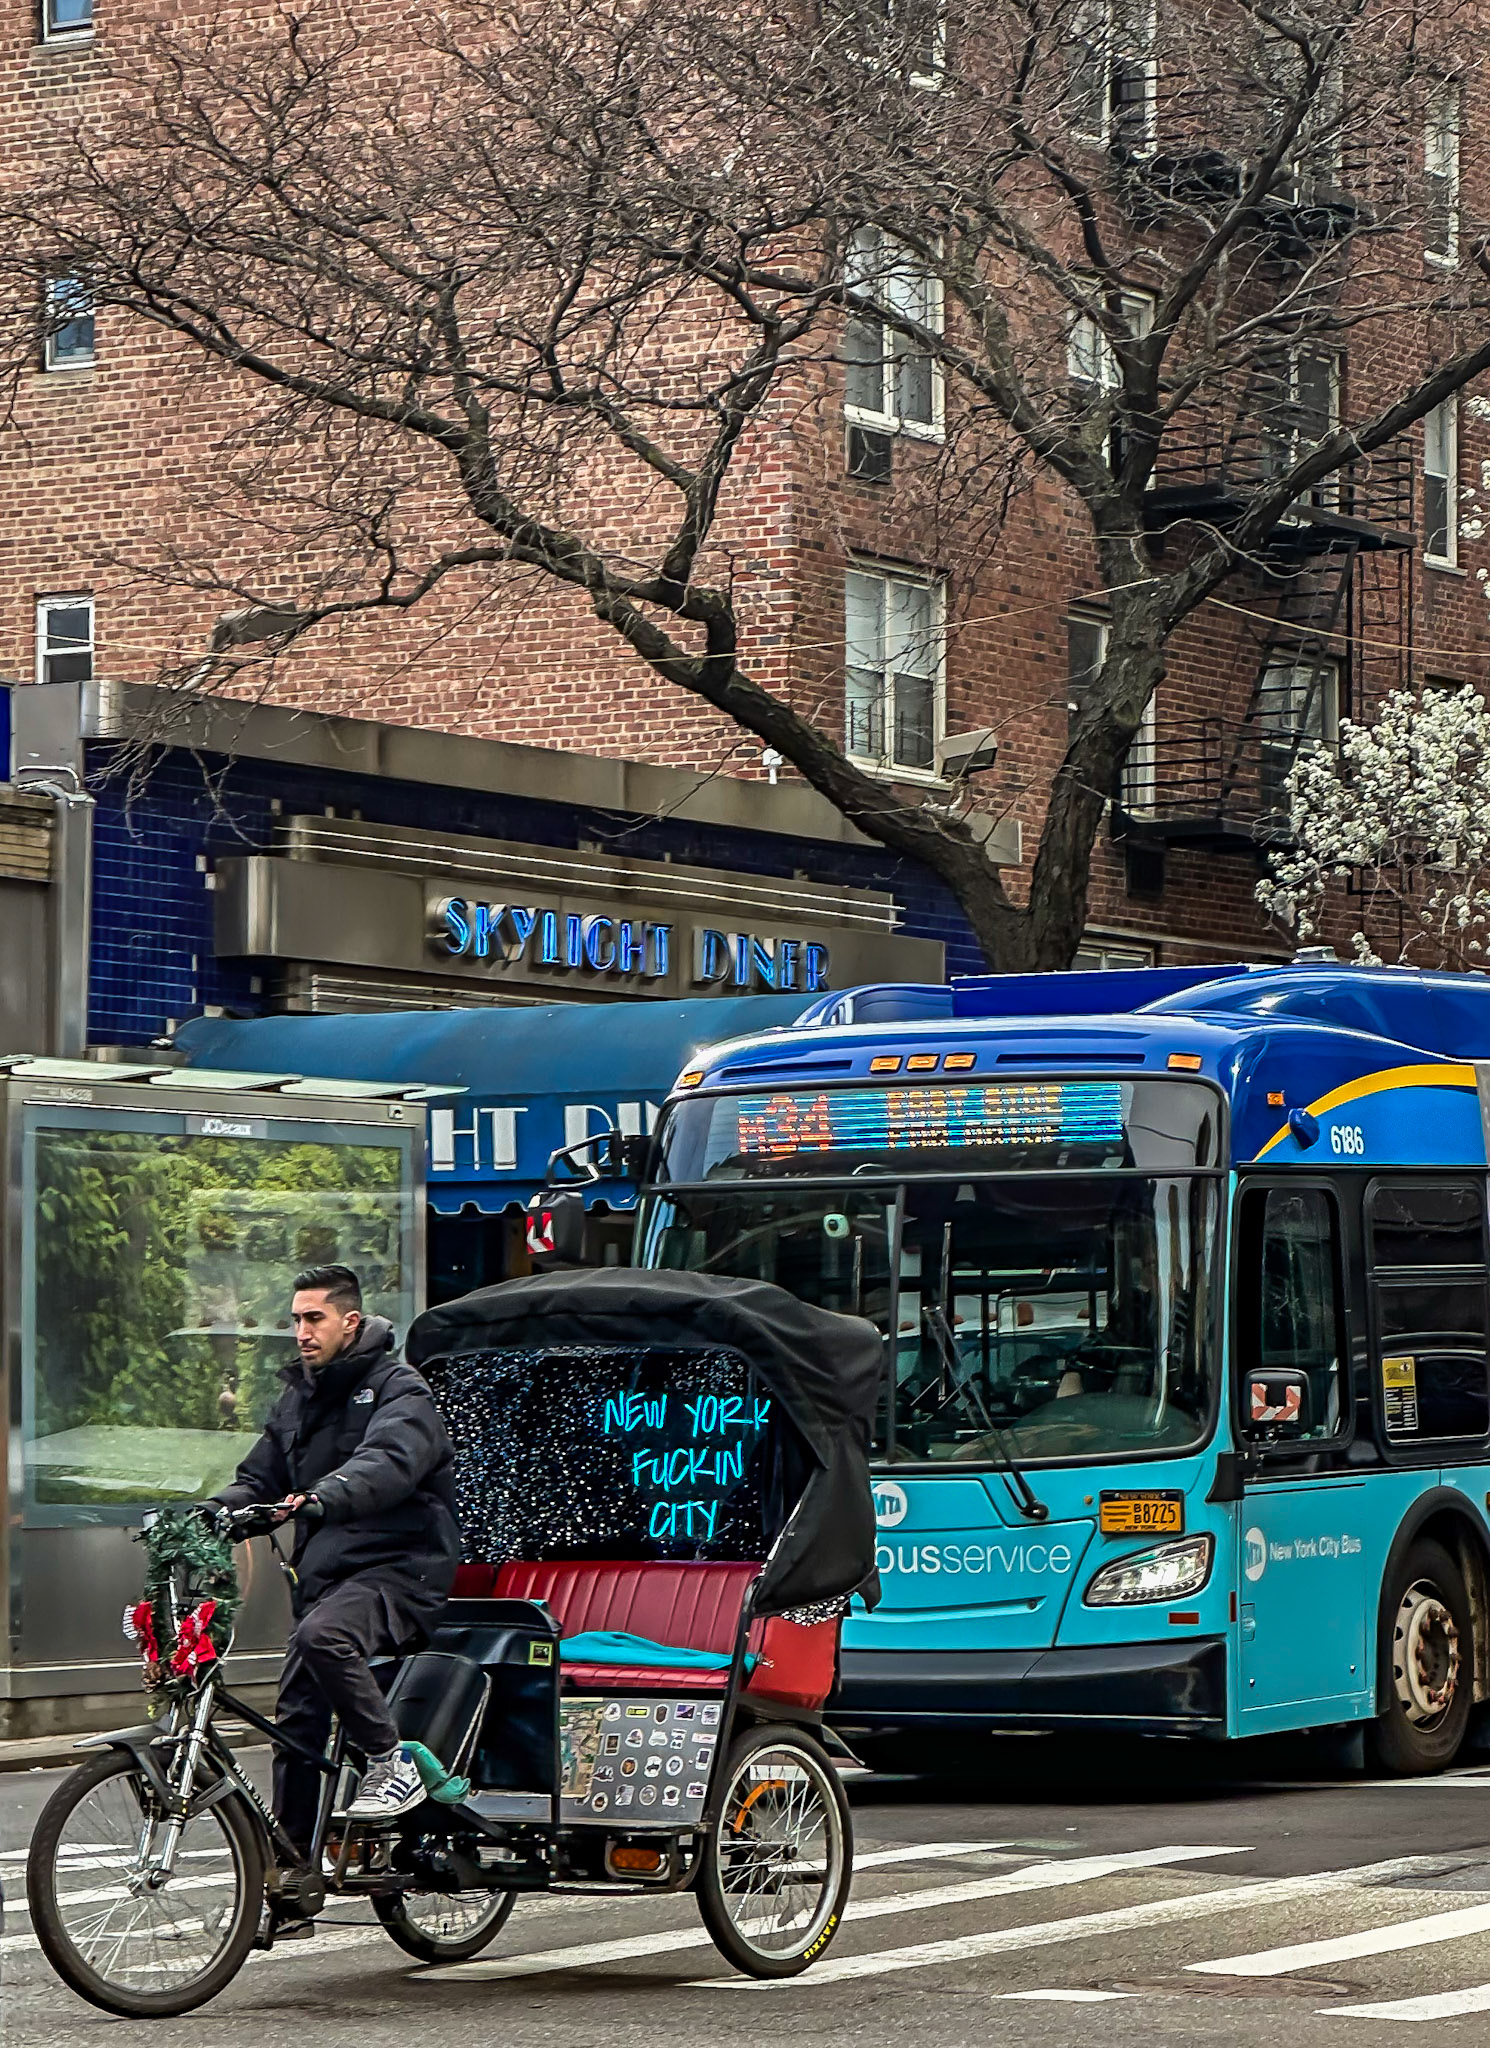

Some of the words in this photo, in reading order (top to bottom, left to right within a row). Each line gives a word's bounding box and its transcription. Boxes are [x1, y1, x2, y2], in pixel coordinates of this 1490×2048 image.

[430, 896, 673, 977] SKYLIGHT
[695, 928, 830, 991] DINER
[1330, 1125, 1365, 1155] 6186
[604, 1391, 667, 1434] NEW
[684, 1395, 771, 1437] YORK
[631, 1440, 743, 1492] FUCKIN
[650, 1500, 718, 1540] CITY
[1269, 1542, 1293, 1560] New
[1294, 1538, 1317, 1558] York
[1319, 1536, 1340, 1558] City
[1341, 1534, 1362, 1554] Bus
[803, 1914, 837, 1960] MAXXIS
